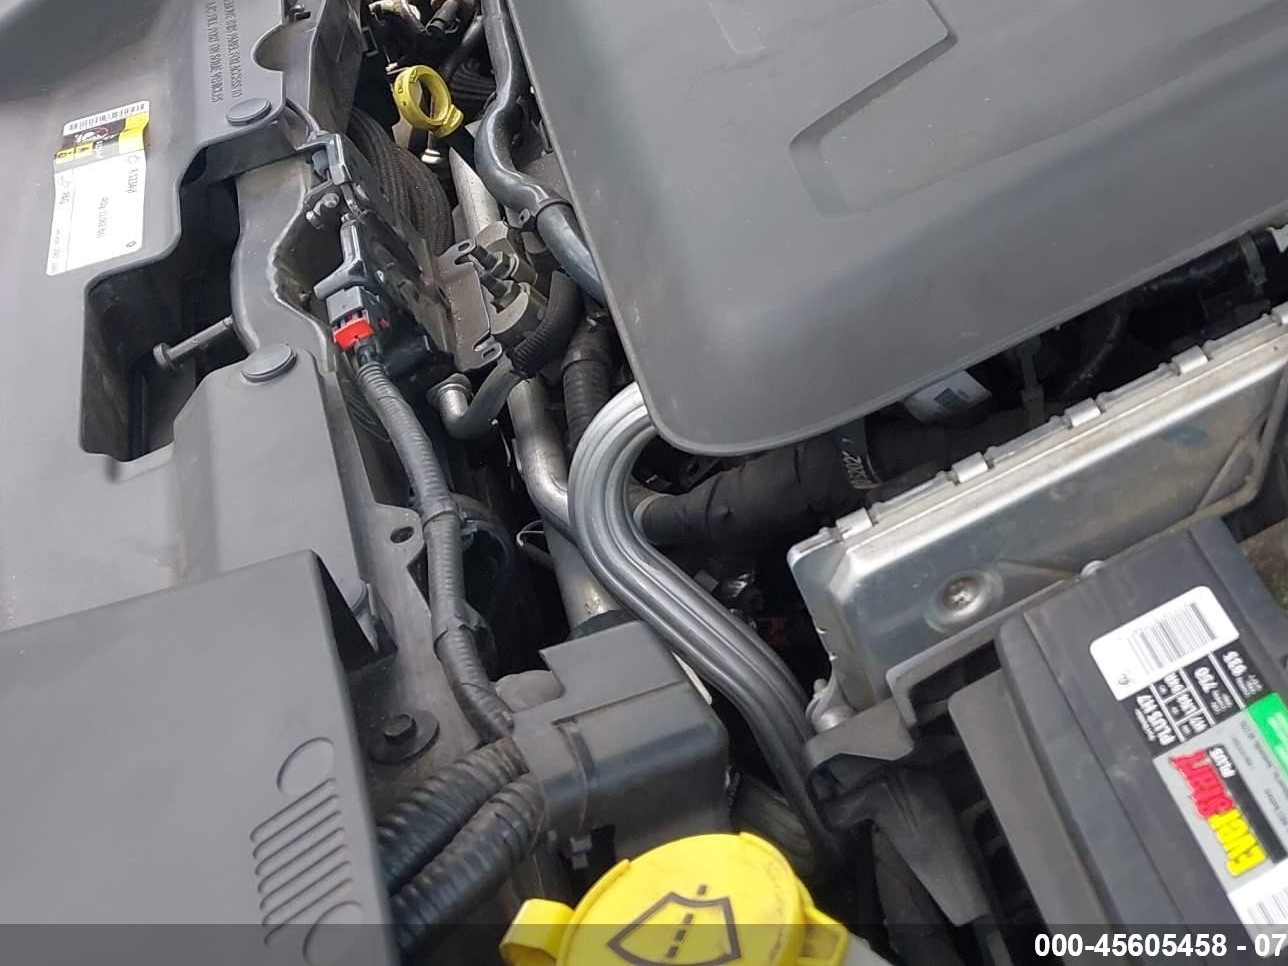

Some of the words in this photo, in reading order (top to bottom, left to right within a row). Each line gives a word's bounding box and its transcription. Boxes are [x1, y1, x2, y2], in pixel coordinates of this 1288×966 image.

[1136, 694, 1158, 714] H7
[1146, 710, 1176, 746] PLUS
[1188, 716, 1208, 734] H7
[1208, 746, 1236, 779] PLUS
[1169, 748, 1267, 877] EverStart
